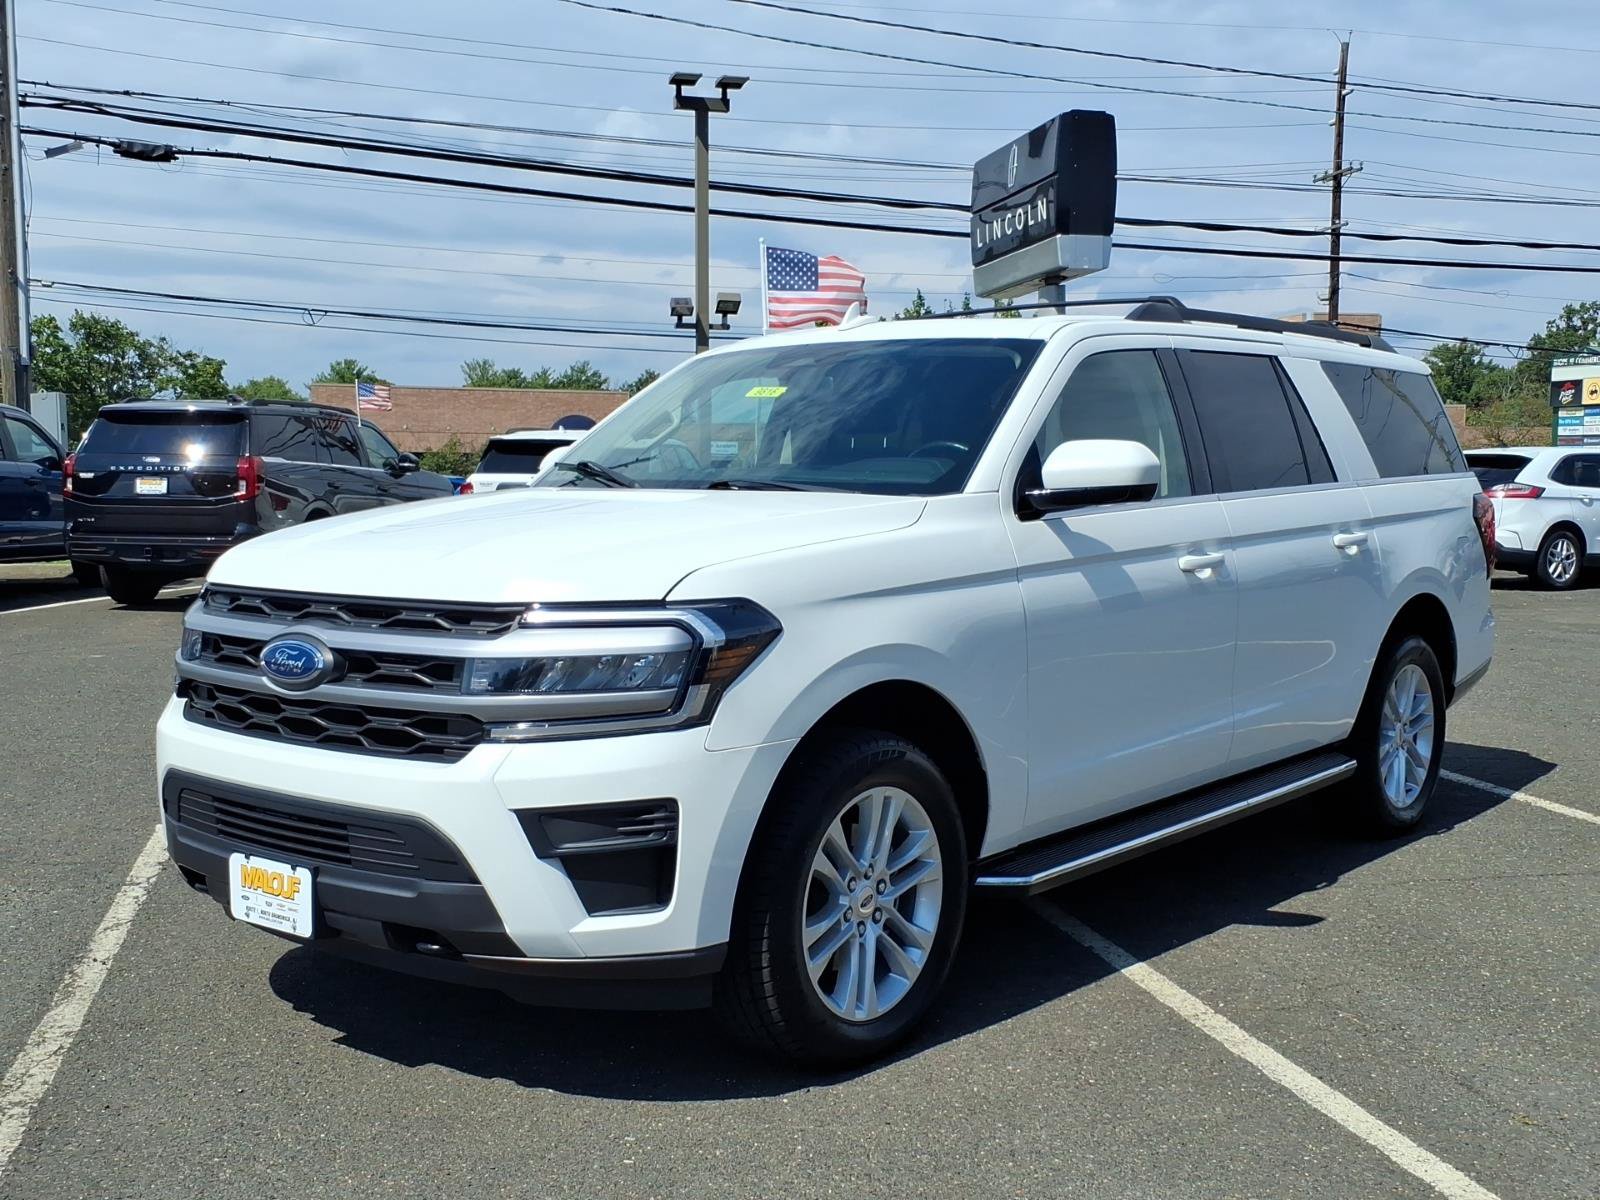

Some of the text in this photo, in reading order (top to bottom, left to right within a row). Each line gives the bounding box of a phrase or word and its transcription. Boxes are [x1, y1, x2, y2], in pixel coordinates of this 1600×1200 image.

[976, 197, 1047, 248] LINCOLN
[271, 648, 306, 668] Ford
[241, 864, 301, 901] MALOUF
